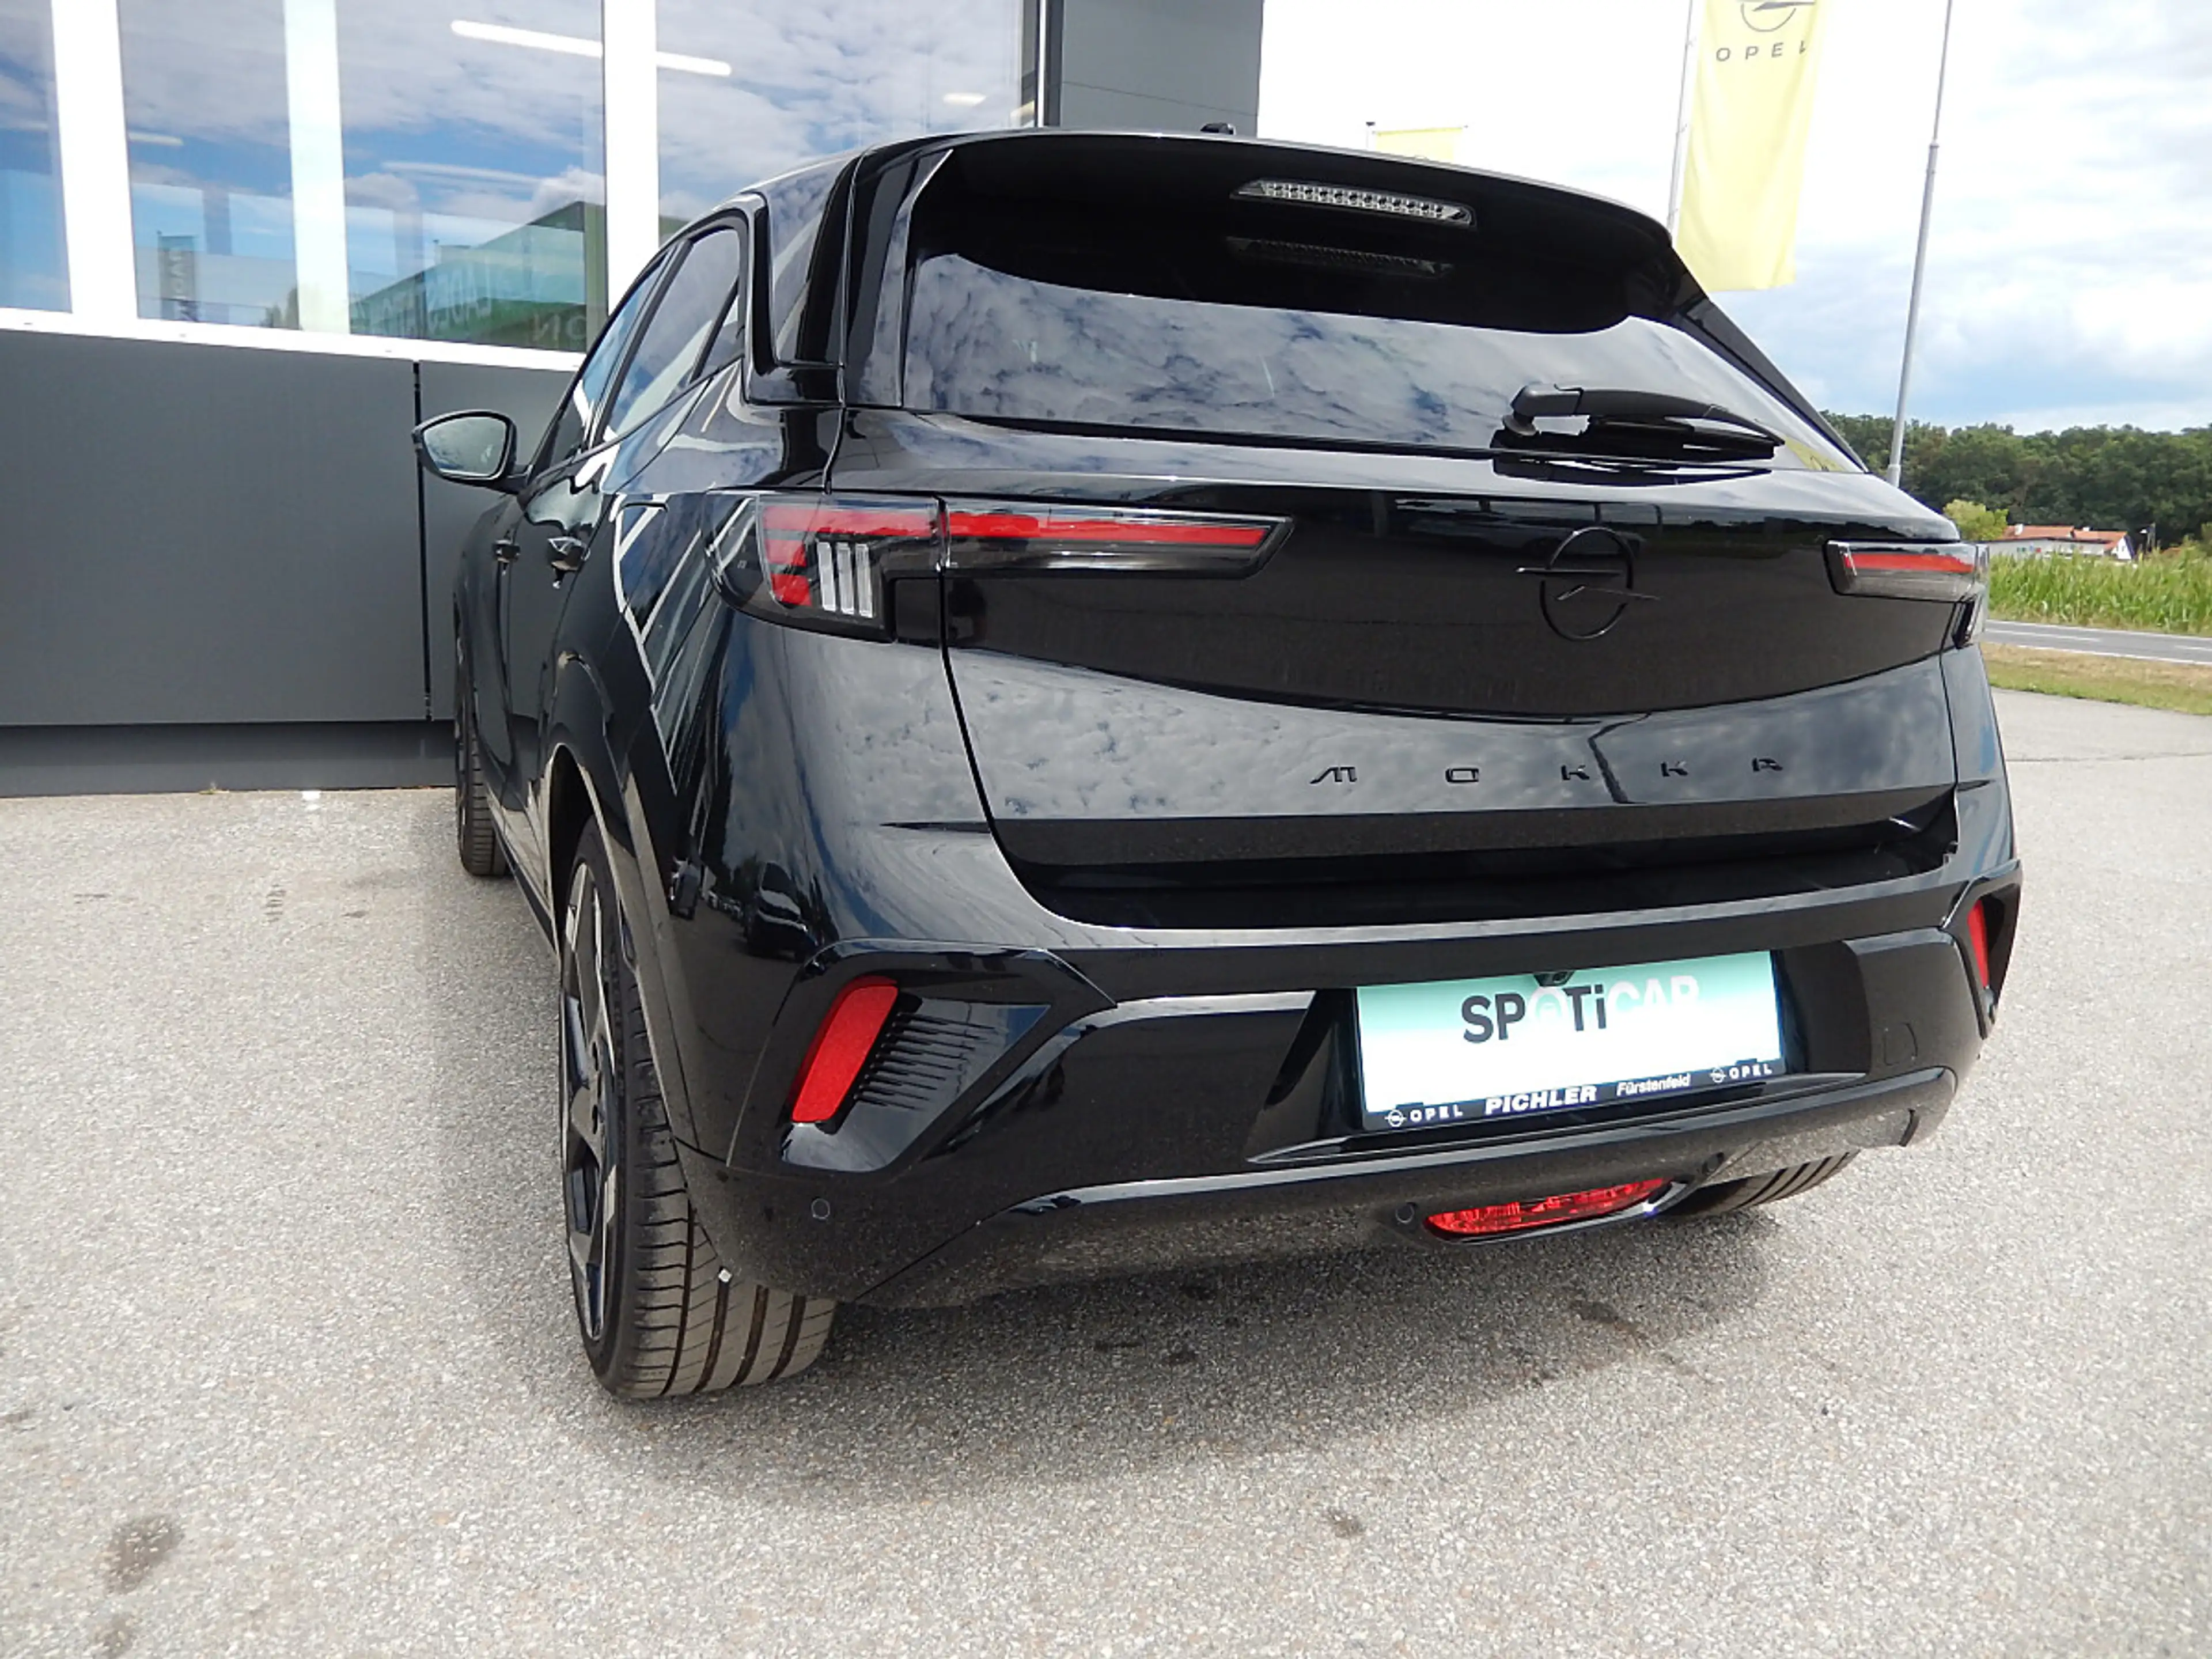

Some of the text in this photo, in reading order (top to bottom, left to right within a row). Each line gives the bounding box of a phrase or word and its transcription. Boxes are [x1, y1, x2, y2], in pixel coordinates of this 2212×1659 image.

[1715, 40, 1806, 62] OPEL
[1309, 755, 1785, 785] MOKKA
[1409, 1063, 1773, 1123] OPEL PICHLER Fürstenfeld OPEL
